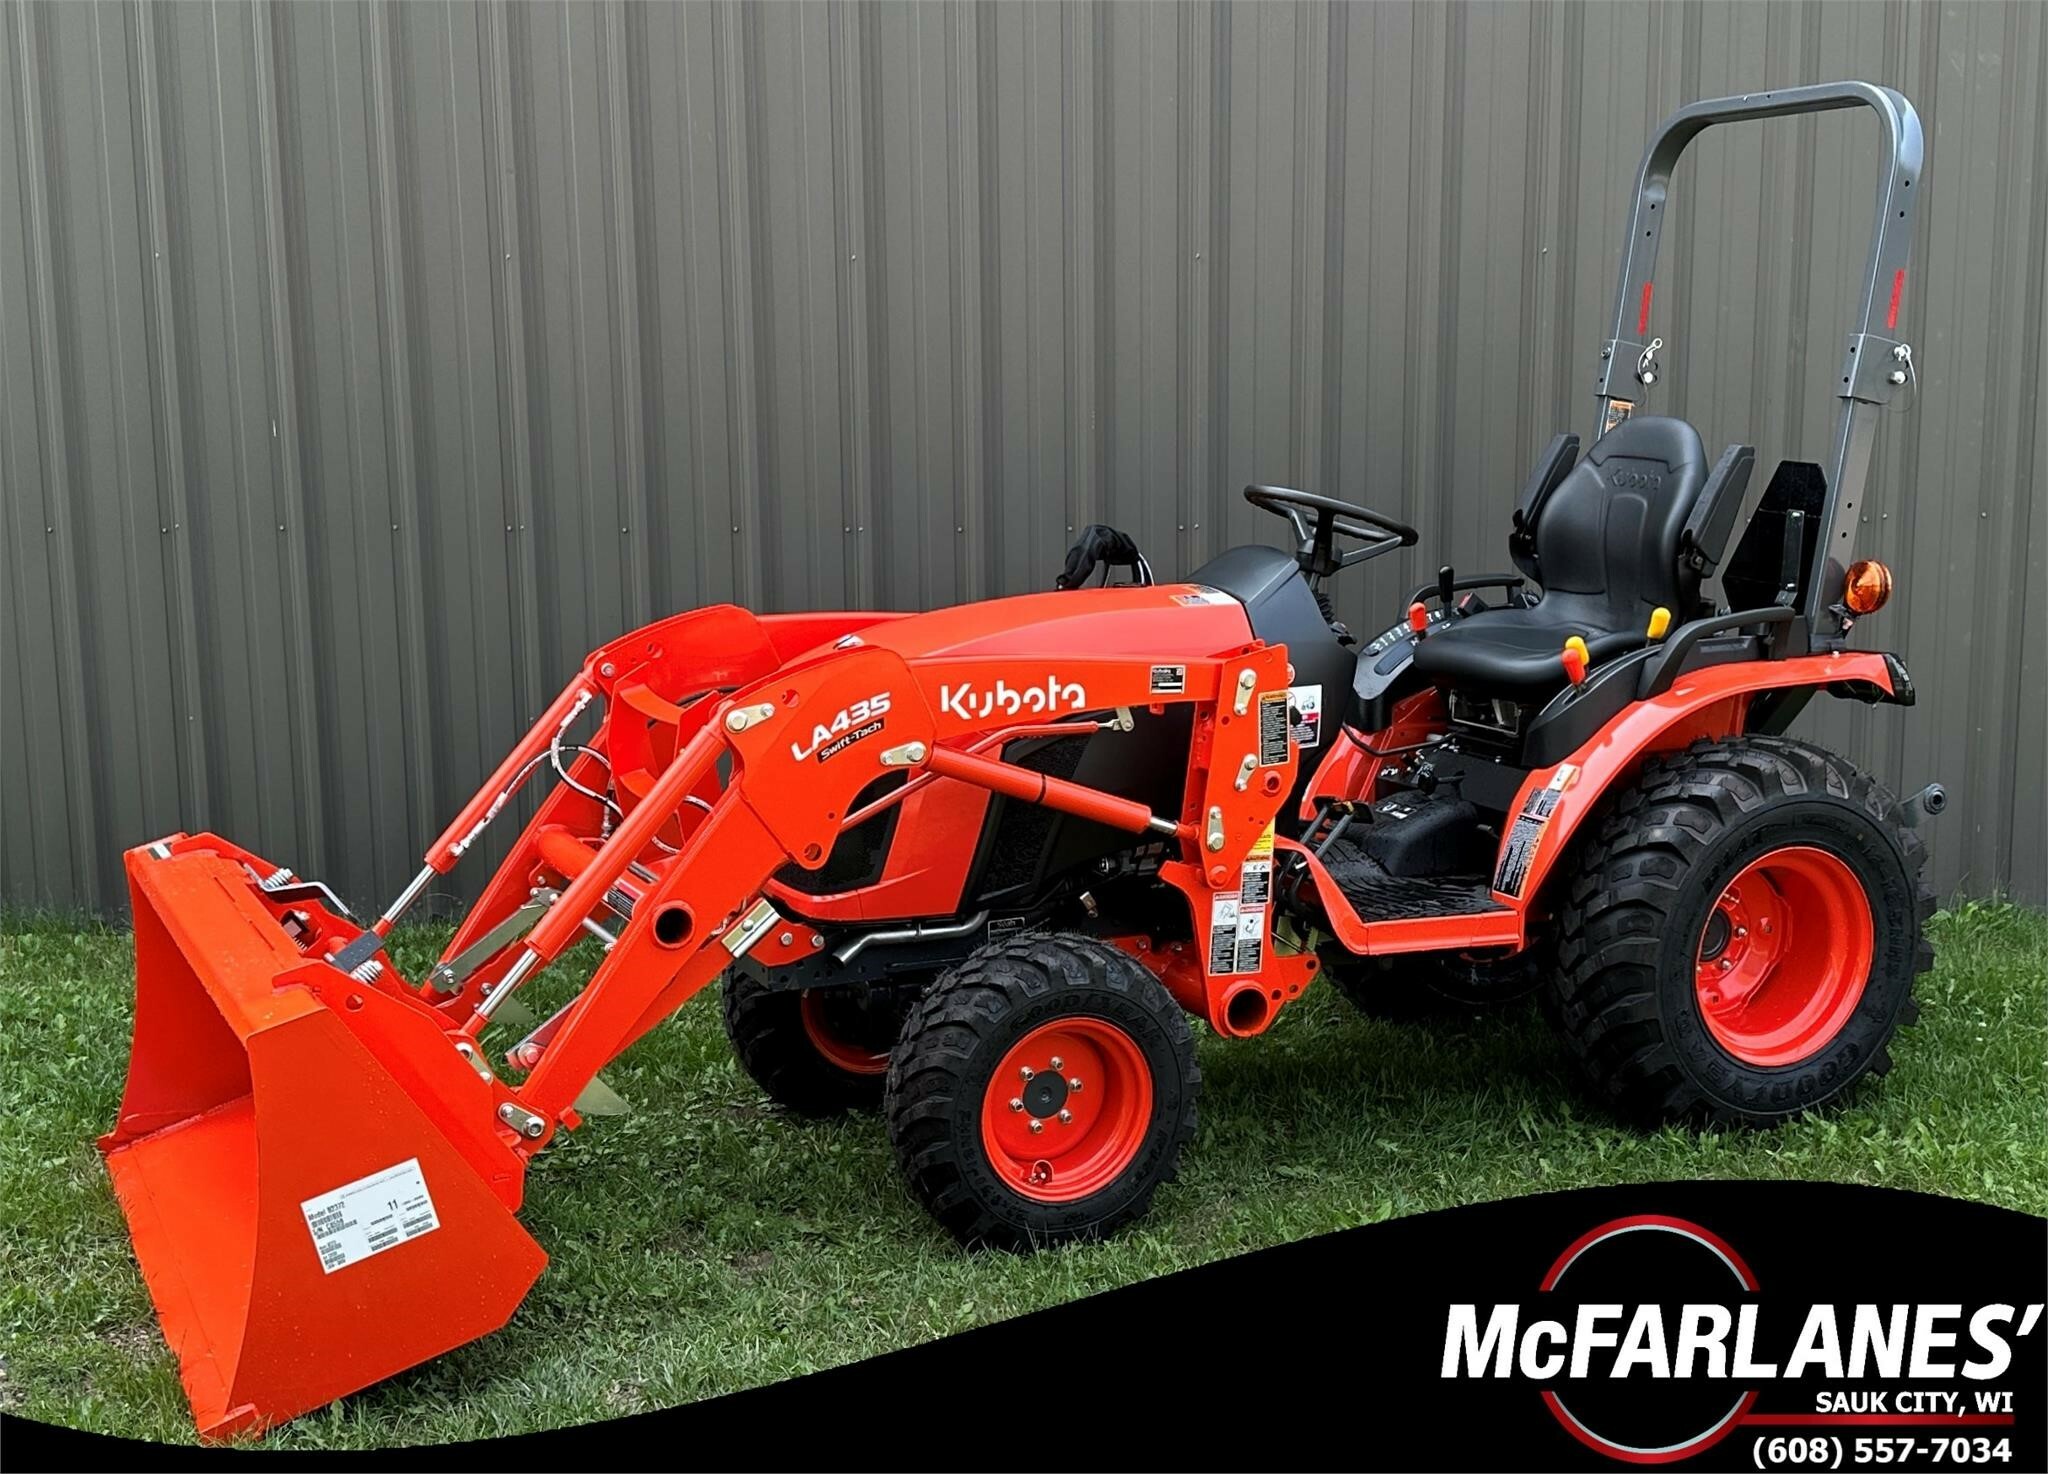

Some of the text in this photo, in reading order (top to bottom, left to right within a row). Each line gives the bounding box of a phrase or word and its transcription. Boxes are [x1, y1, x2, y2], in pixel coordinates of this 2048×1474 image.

[940, 675, 1086, 720] Kubota
[790, 691, 892, 761] LA435
[820, 721, 882, 761] Swift-Tach
